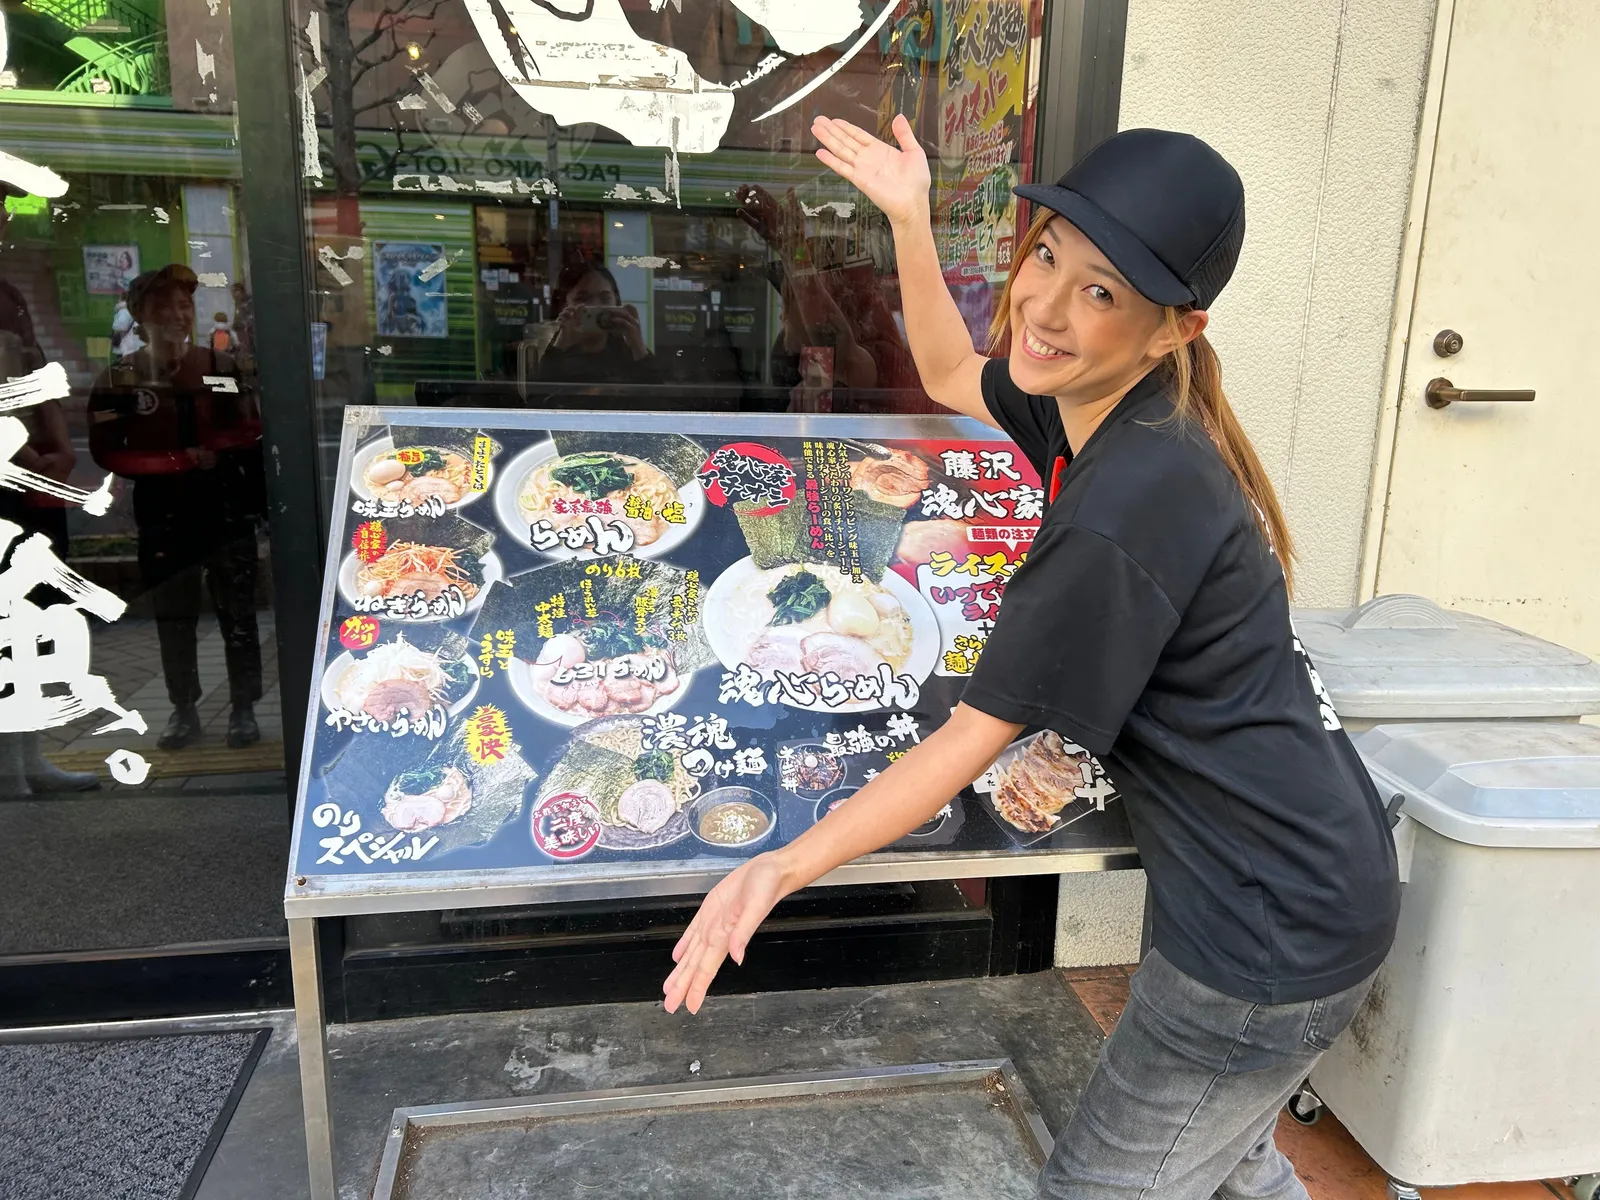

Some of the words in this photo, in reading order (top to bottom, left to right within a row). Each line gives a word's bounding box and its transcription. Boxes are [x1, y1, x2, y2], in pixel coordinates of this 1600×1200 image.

[939, 450, 1022, 481] 藤沢
[921, 483, 1045, 520] 魂心家
[530, 515, 635, 556] らーめん
[972, 528, 1036, 541] 麺類の注文
[930, 577, 1007, 605] いつで
[954, 635, 988, 651] さら
[718, 663, 920, 710] 魂心らーめん
[325, 704, 447, 741] やさいらーめん
[475, 707, 506, 760] 豪快
[822, 712, 921, 758] 最強の丼
[681, 747, 768, 779] つけ麺
[312, 803, 361, 837] のり
[316, 832, 440, 865] スペシャル
